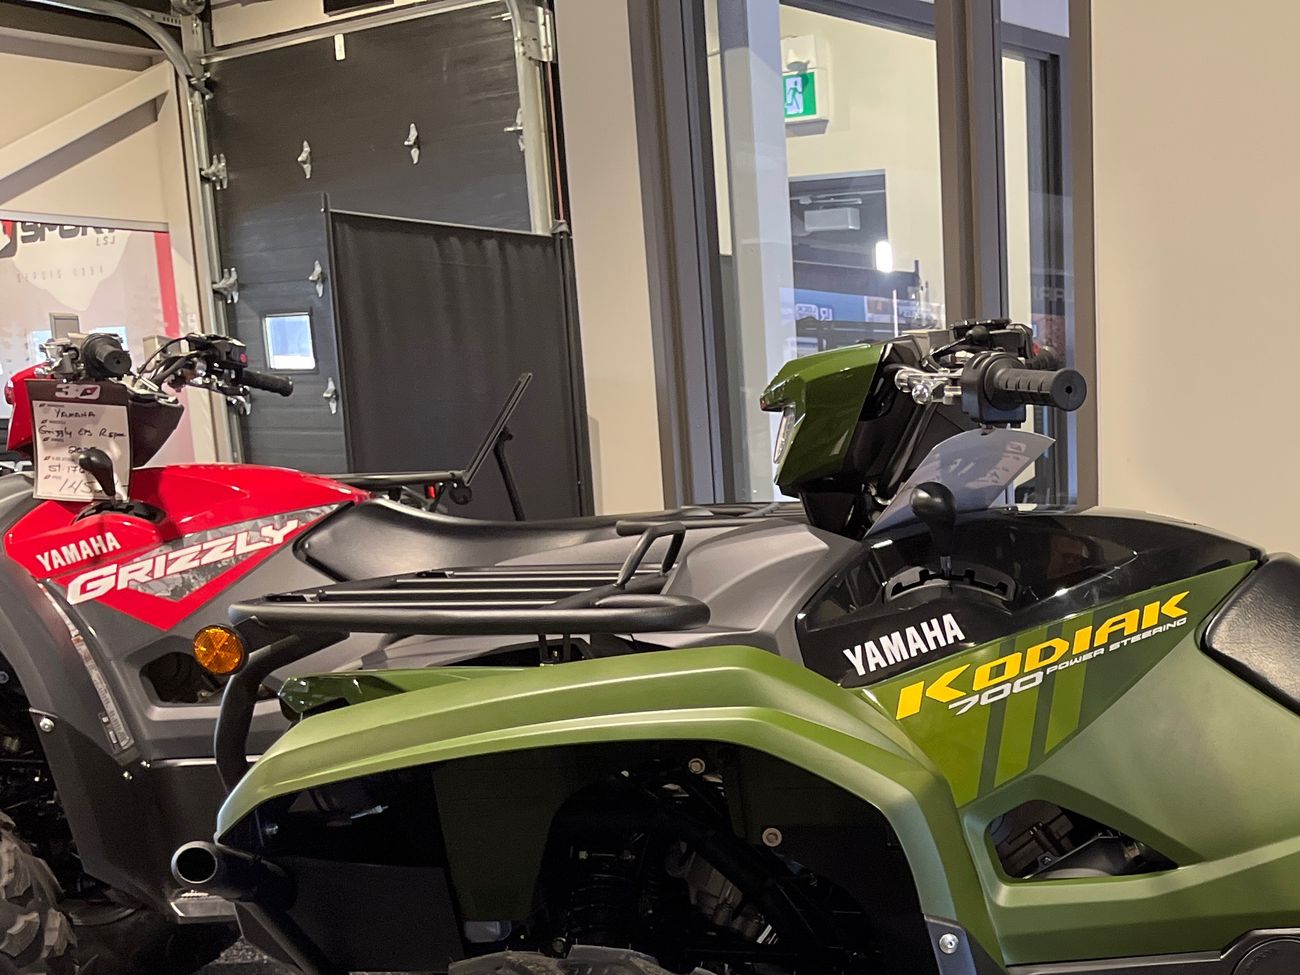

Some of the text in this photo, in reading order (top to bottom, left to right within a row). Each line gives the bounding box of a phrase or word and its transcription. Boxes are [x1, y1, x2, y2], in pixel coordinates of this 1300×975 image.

[20, 222, 115, 243] SPO
[96, 235, 116, 247] LSJ
[36, 531, 121, 573] YAMAHA
[66, 519, 299, 605] GRIZZLY
[843, 612, 966, 677] YAMAHA
[896, 591, 1190, 720] KODIAK
[948, 617, 1188, 716] 700 POWER STEERING
